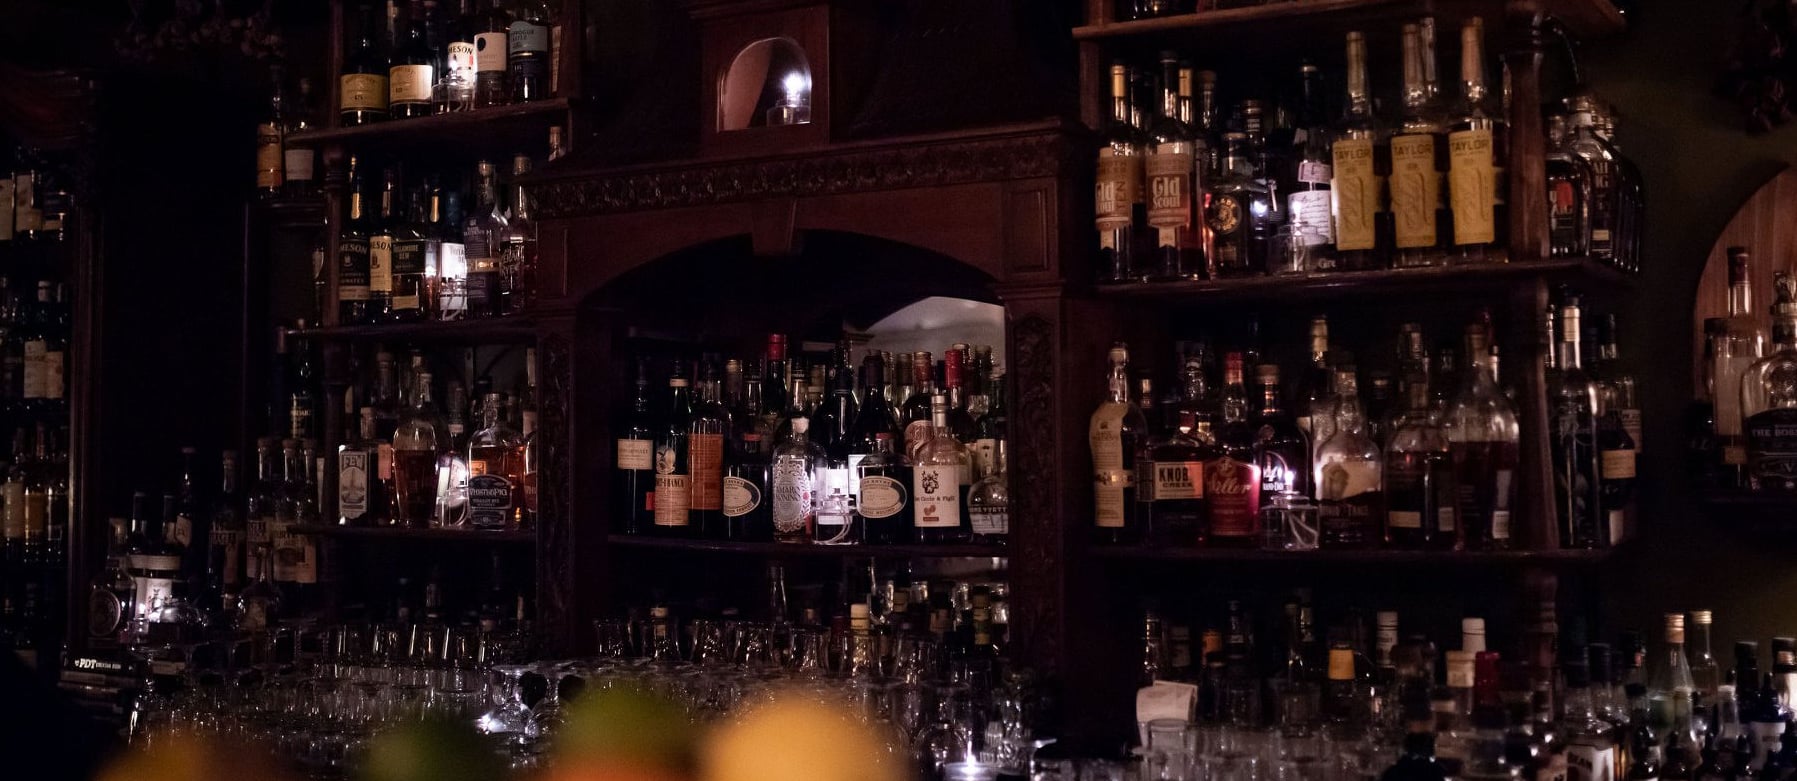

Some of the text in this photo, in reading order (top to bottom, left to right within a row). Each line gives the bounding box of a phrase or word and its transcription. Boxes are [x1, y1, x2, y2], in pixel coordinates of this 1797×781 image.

[1393, 143, 1432, 156] TAYLOR
[1450, 139, 1489, 152] TAYLOR
[1335, 148, 1371, 159] TAYLOR
[1159, 467, 1188, 482] KNOB
[79, 657, 97, 670] PDT
